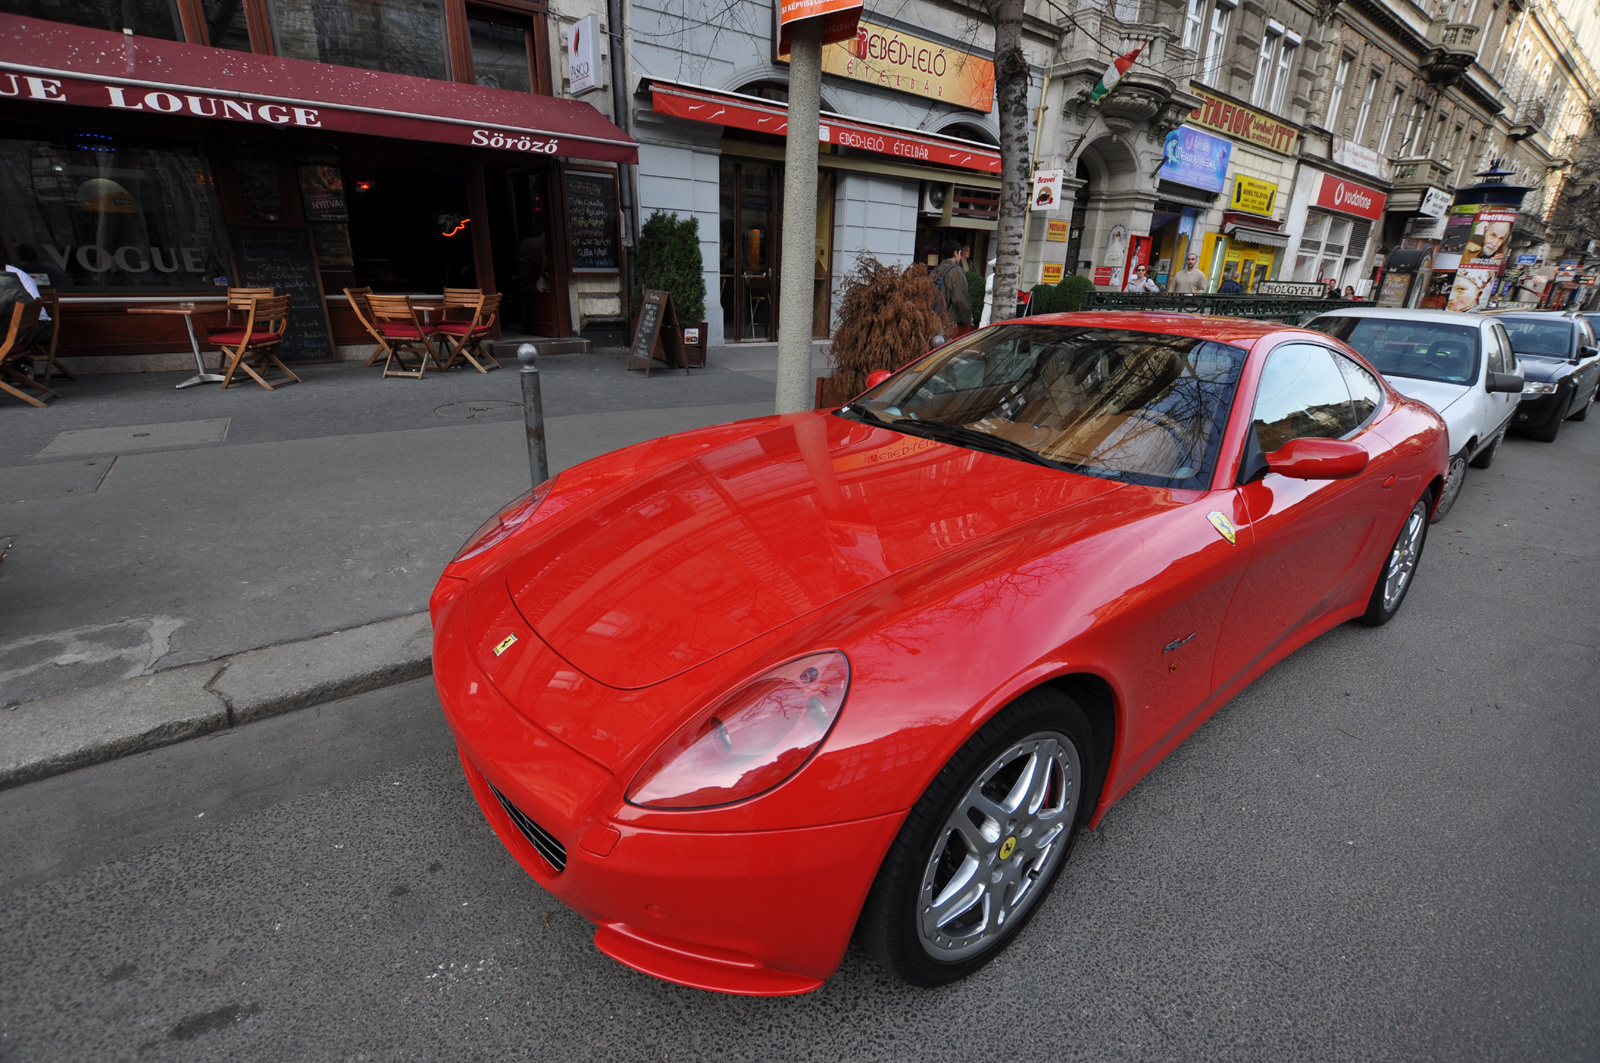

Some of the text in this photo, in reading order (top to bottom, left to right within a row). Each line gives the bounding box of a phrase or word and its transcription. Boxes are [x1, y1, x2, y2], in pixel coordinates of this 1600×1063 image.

[868, 34, 947, 78] EBÉD-LELŐ
[105, 86, 322, 128] LOUNGE
[470, 129, 559, 154] Söröző
[839, 131, 929, 160] EBÉD-LELŐ ÉTELBÁR
[1271, 125, 1295, 152] ITT
[1344, 189, 1372, 210] vodafone
[42, 244, 206, 273] VOGUE
